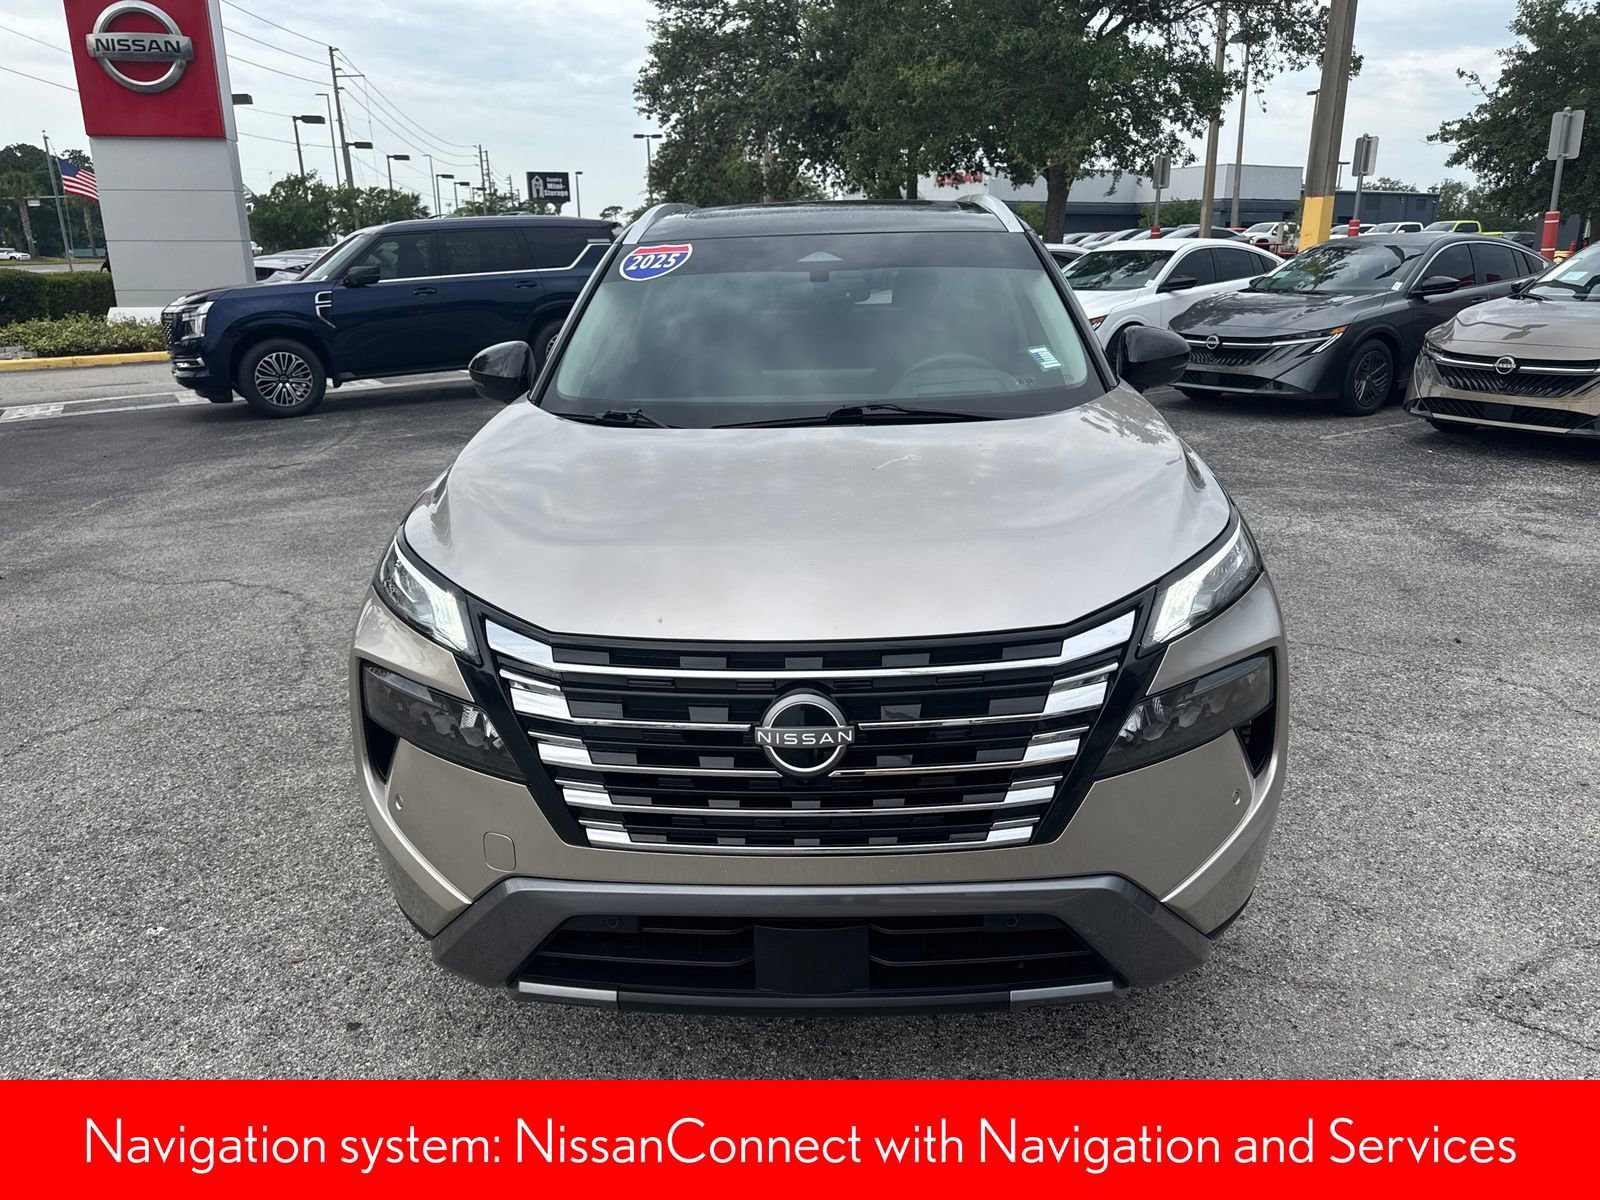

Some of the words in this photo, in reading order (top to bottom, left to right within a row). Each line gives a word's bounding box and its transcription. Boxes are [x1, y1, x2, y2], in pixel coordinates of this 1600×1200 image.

[95, 38, 181, 53] NISSAN
[625, 253, 680, 271] 2025
[757, 730, 852, 745] NISSAN
